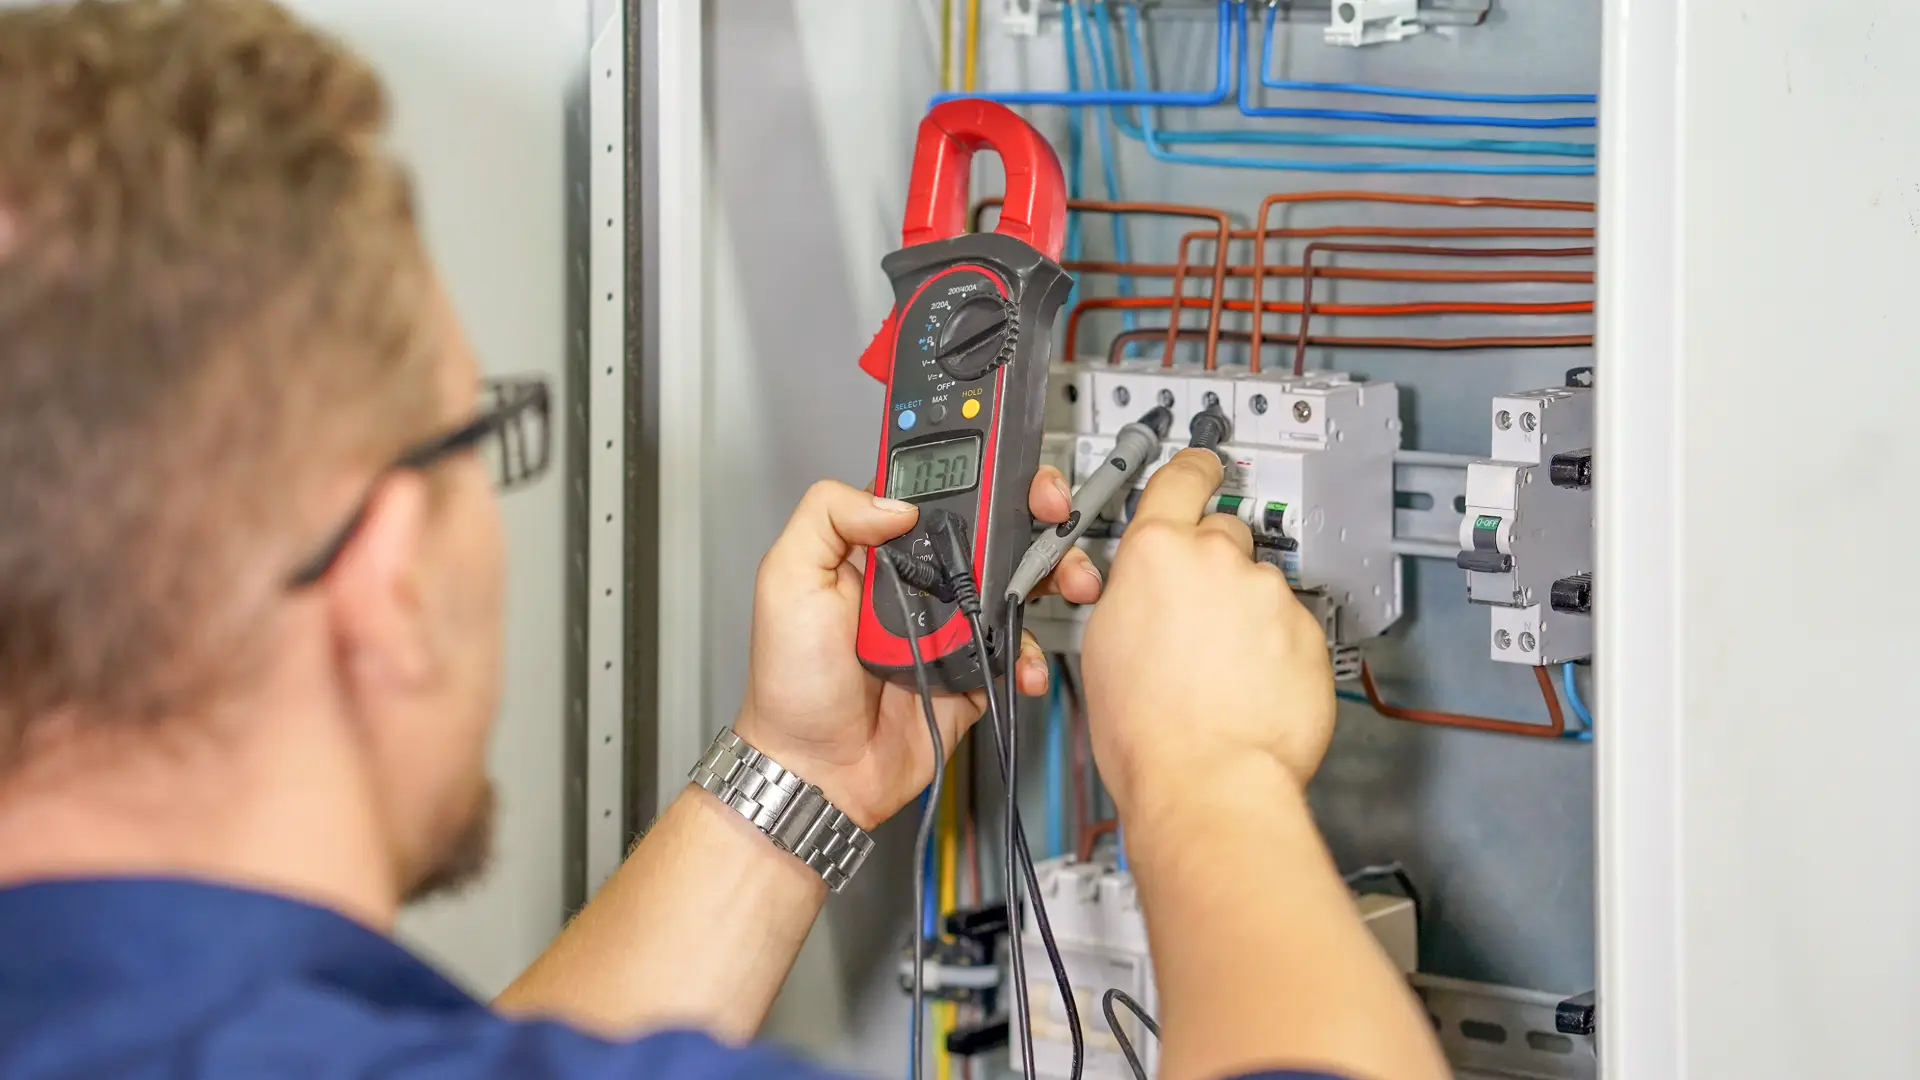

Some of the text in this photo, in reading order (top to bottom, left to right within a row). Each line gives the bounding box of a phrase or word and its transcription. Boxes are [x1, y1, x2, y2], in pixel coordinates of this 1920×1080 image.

[948, 284, 977, 295] 200/400A
[931, 301, 949, 310] 2/20A
[937, 382, 951, 391] OFF
[962, 388, 983, 398] HOLD
[932, 394, 948, 403] MAX
[894, 399, 923, 411] SELECT
